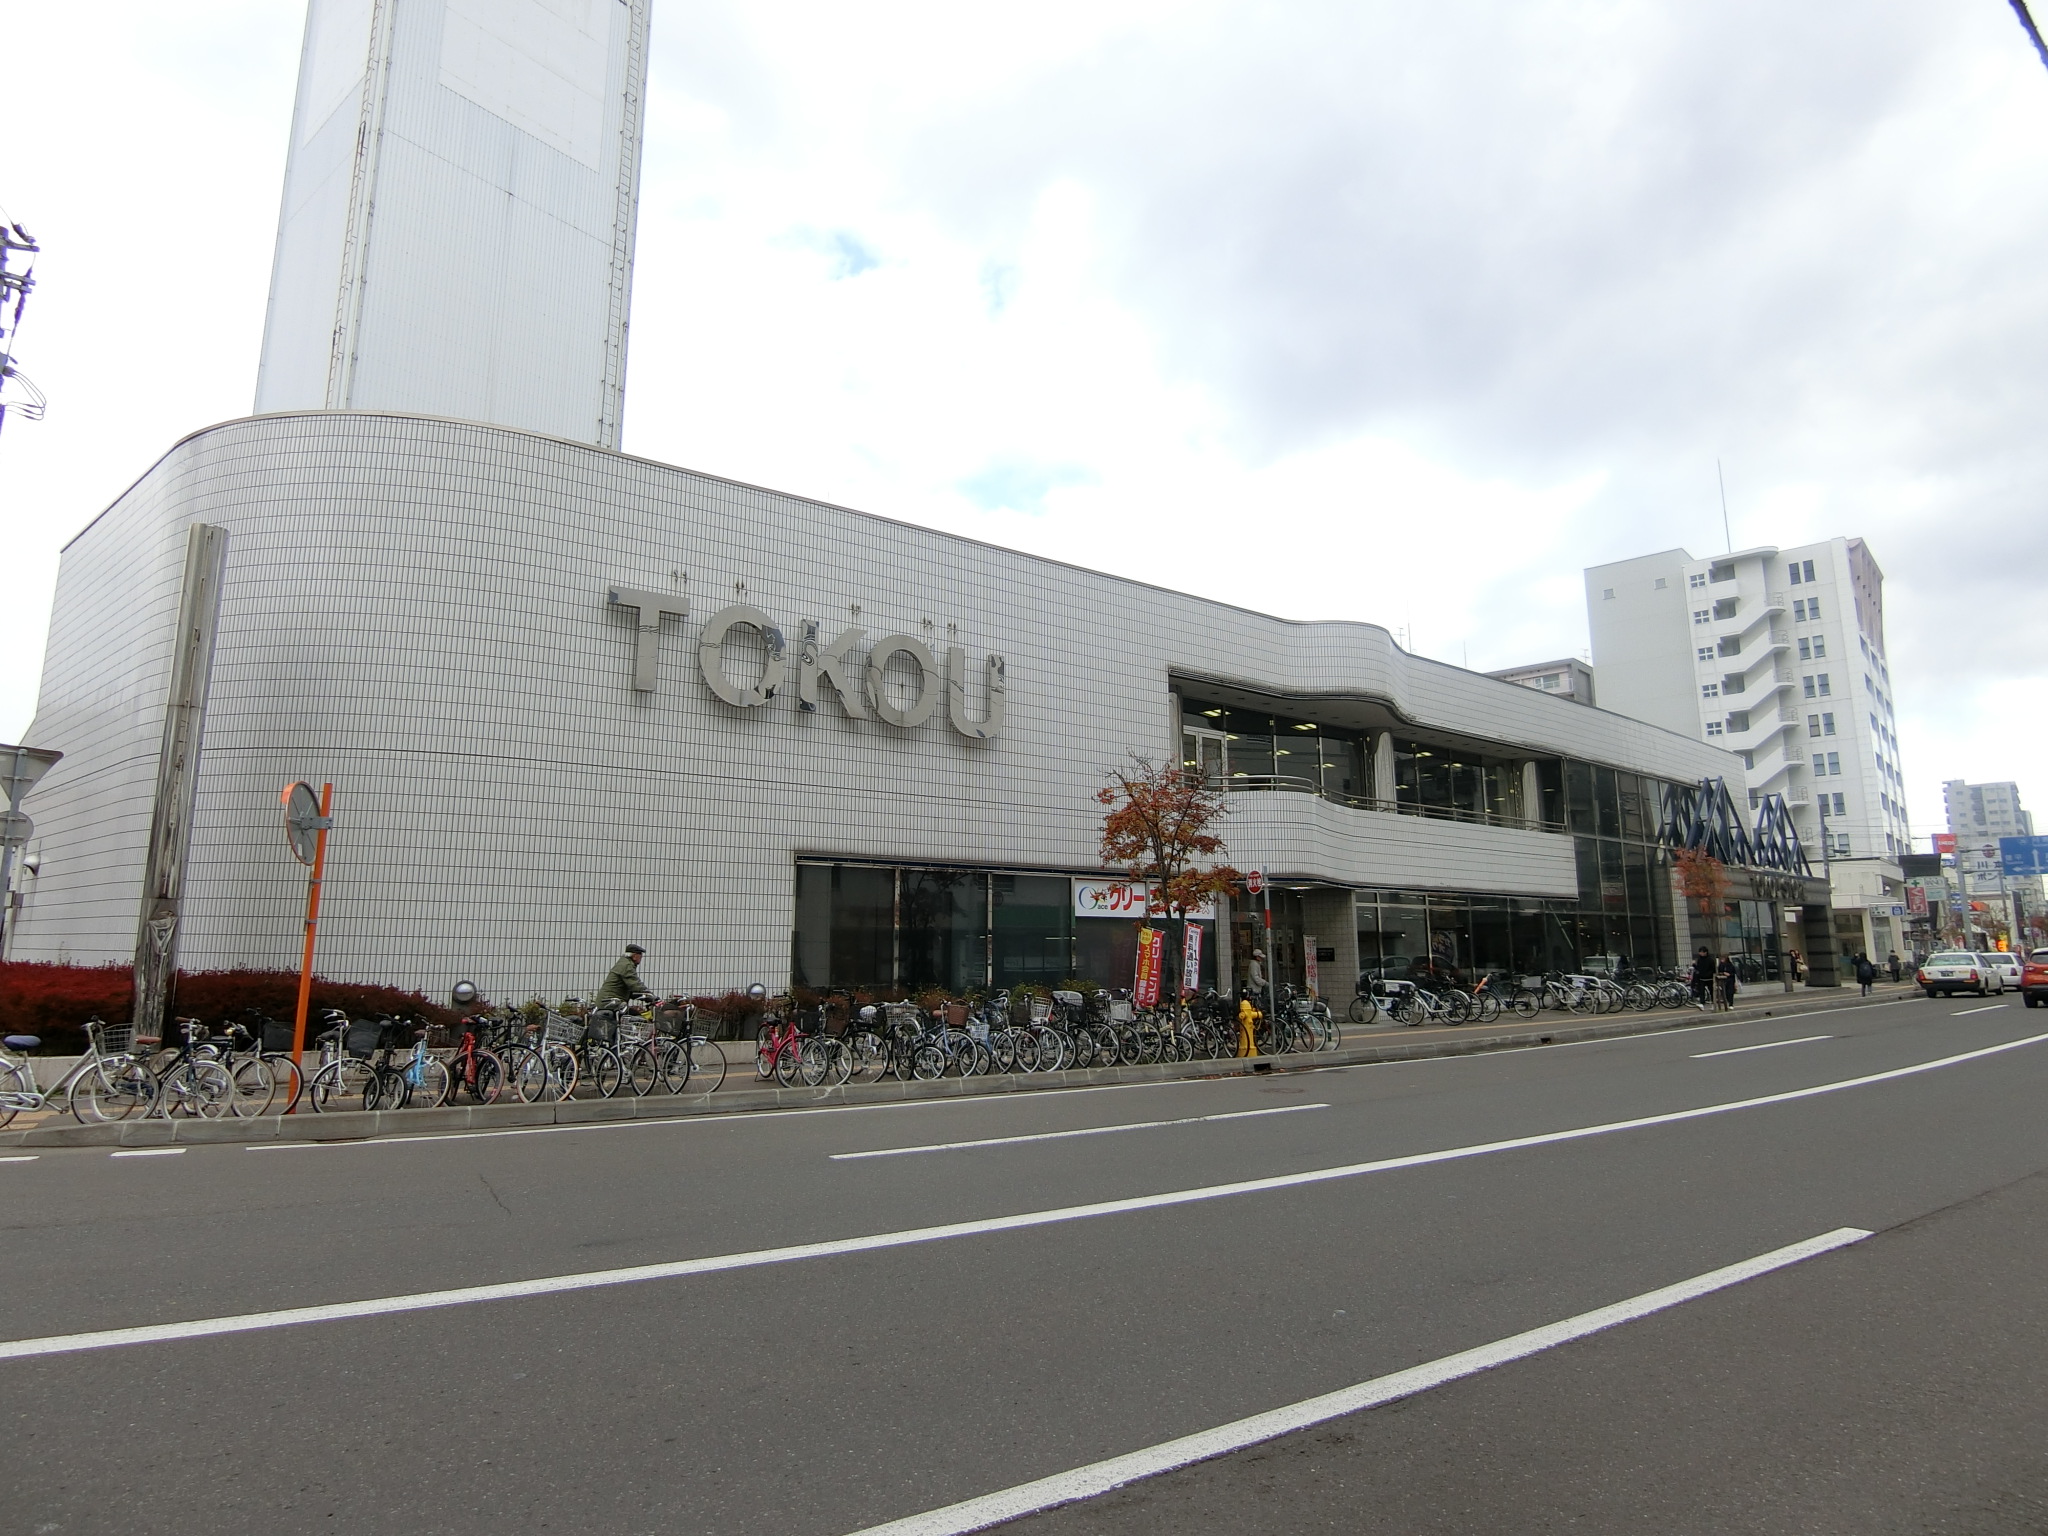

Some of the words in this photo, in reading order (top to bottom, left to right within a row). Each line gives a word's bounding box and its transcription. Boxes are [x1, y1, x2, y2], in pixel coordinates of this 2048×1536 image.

[608, 584, 1005, 740] TOKOU
[1146, 937, 1160, 1003] クリーニング
